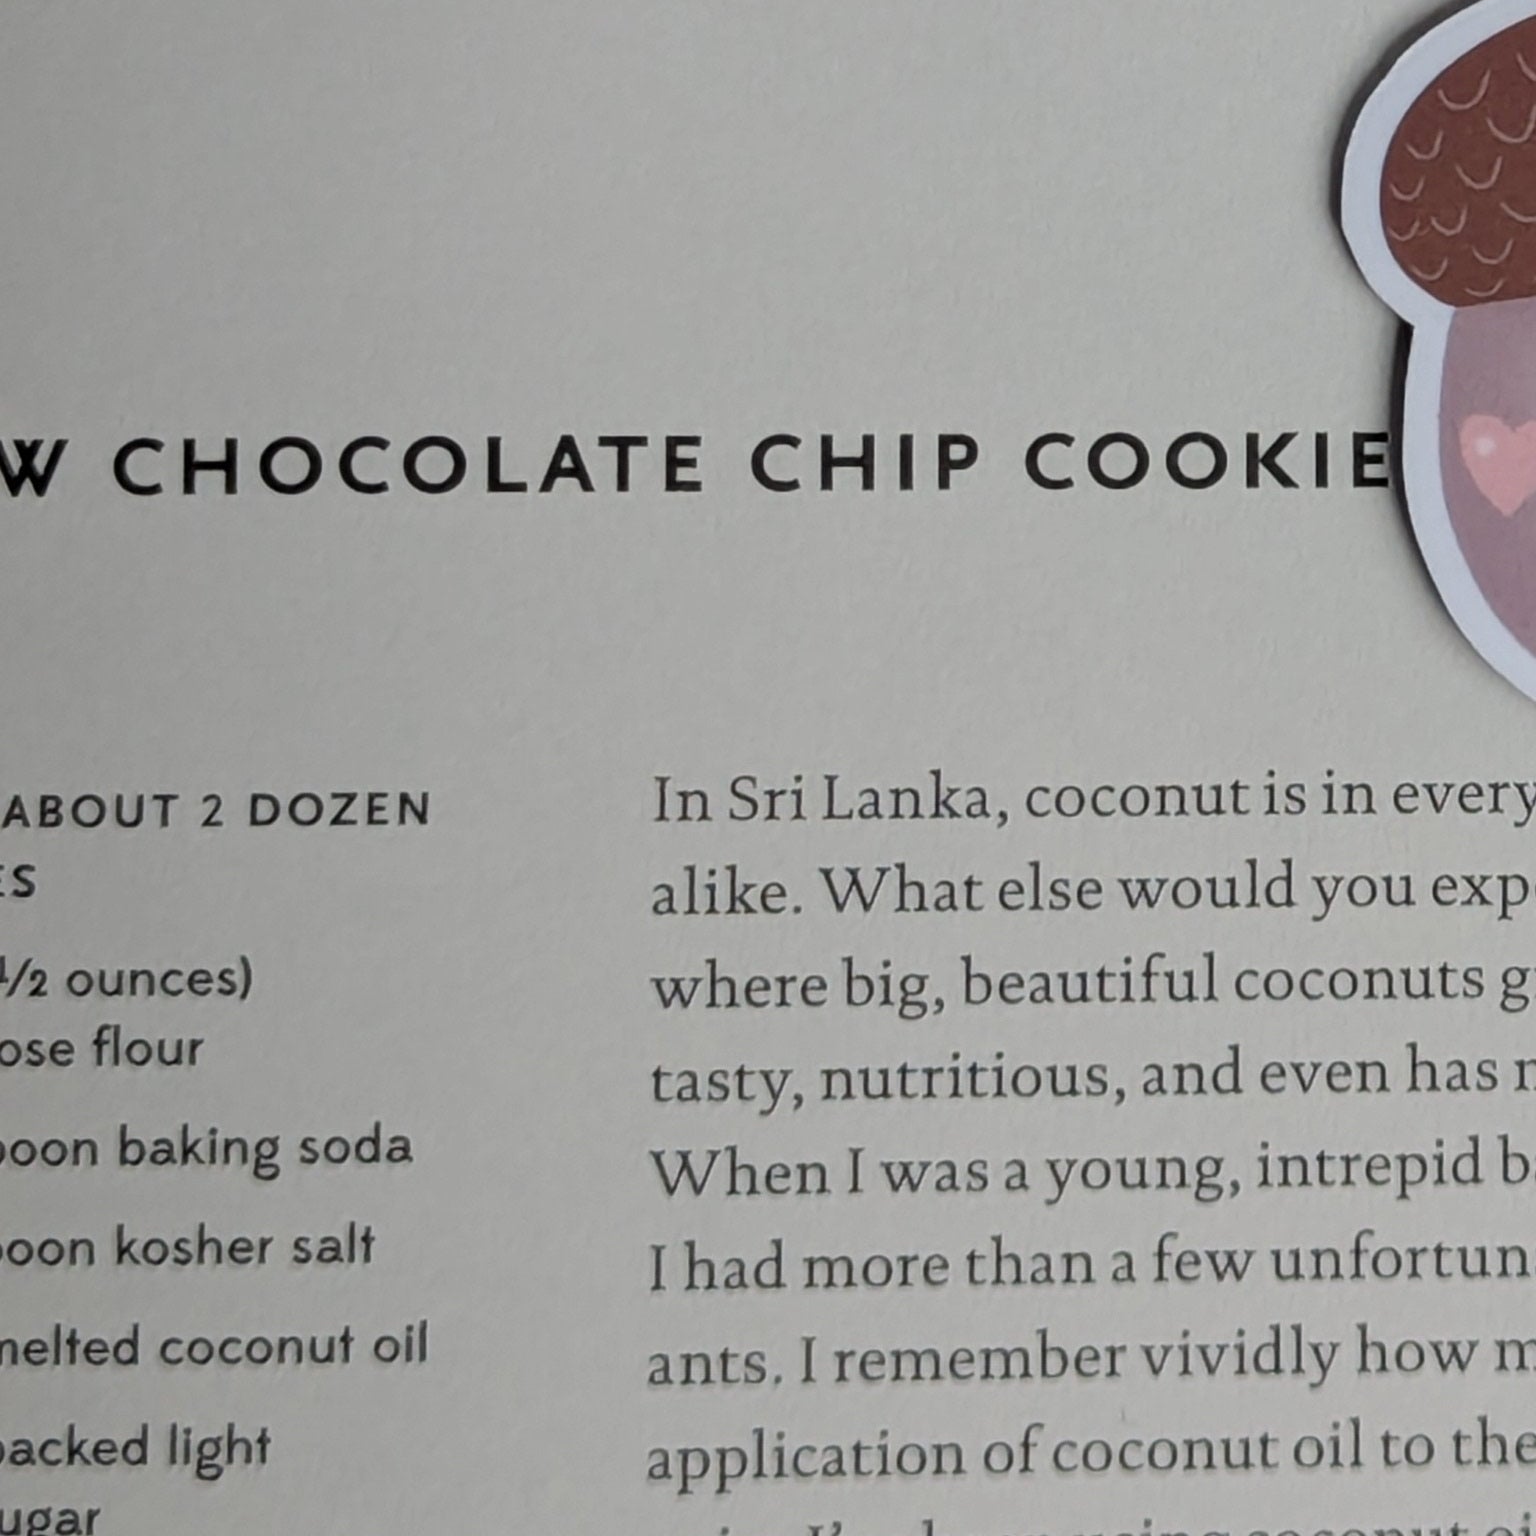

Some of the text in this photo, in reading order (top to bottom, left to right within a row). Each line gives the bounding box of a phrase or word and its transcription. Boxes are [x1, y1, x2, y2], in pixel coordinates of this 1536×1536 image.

[113, 434, 702, 496] CHOCOLATE
[750, 433, 979, 492] CHIP
[1024, 431, 1389, 490] COOKIE
[2, 792, 429, 829] ABOUT 2 DOZEN
[654, 776, 712, 822] In
[729, 774, 806, 821] Sri
[822, 769, 1008, 828] Lanka,
[1026, 779, 1250, 818] coconut
[1263, 769, 1306, 815] is
[1322, 769, 1377, 814] in
[652, 864, 802, 916] alike.
[818, 862, 984, 913] What
[998, 860, 1102, 911] else
[1117, 857, 1297, 910] would
[1311, 875, 1416, 922] you
[66, 955, 252, 1001] ounces)
[650, 958, 827, 1009] where
[841, 956, 944, 1021] big,
[960, 951, 1218, 1005] beautiful
[1235, 962, 1484, 1001] coconuts
[92, 1024, 204, 1067] flour
[652, 1064, 803, 1117] tasty,
[820, 1052, 1125, 1106] nutritious,
[1143, 1044, 1243, 1096] and
[1260, 1061, 1390, 1094] even
[1406, 1041, 1498, 1092] has
[0, 1121, 413, 1182] oon baking soda
[649, 1145, 831, 1197] When
[848, 1148, 864, 1194] I
[880, 1159, 988, 1193] was
[1005, 1159, 1029, 1192] a
[1045, 1156, 1240, 1206] young,
[1257, 1134, 1484, 1201] intrepid
[0, 1221, 375, 1267] oon kosher salt
[651, 1245, 666, 1292] I
[684, 1238, 787, 1291] had
[803, 1254, 949, 1289] more
[966, 1234, 1096, 1286] than
[1112, 1251, 1136, 1284] a
[1153, 1232, 1256, 1284] few
[159, 1326, 354, 1366] coconut
[373, 1319, 427, 1363] oil
[648, 1347, 782, 1386] ants.
[801, 1337, 816, 1384] I
[834, 1328, 1127, 1383] remember
[1140, 1323, 1340, 1390] vividly
[1356, 1322, 1479, 1375] how
[0, 1422, 271, 1482] acked light
[647, 1427, 966, 1496] application
[983, 1422, 1044, 1474] of
[1052, 1432, 1278, 1473] coconut
[1293, 1416, 1363, 1469] oil
[1381, 1430, 1434, 1468] to
